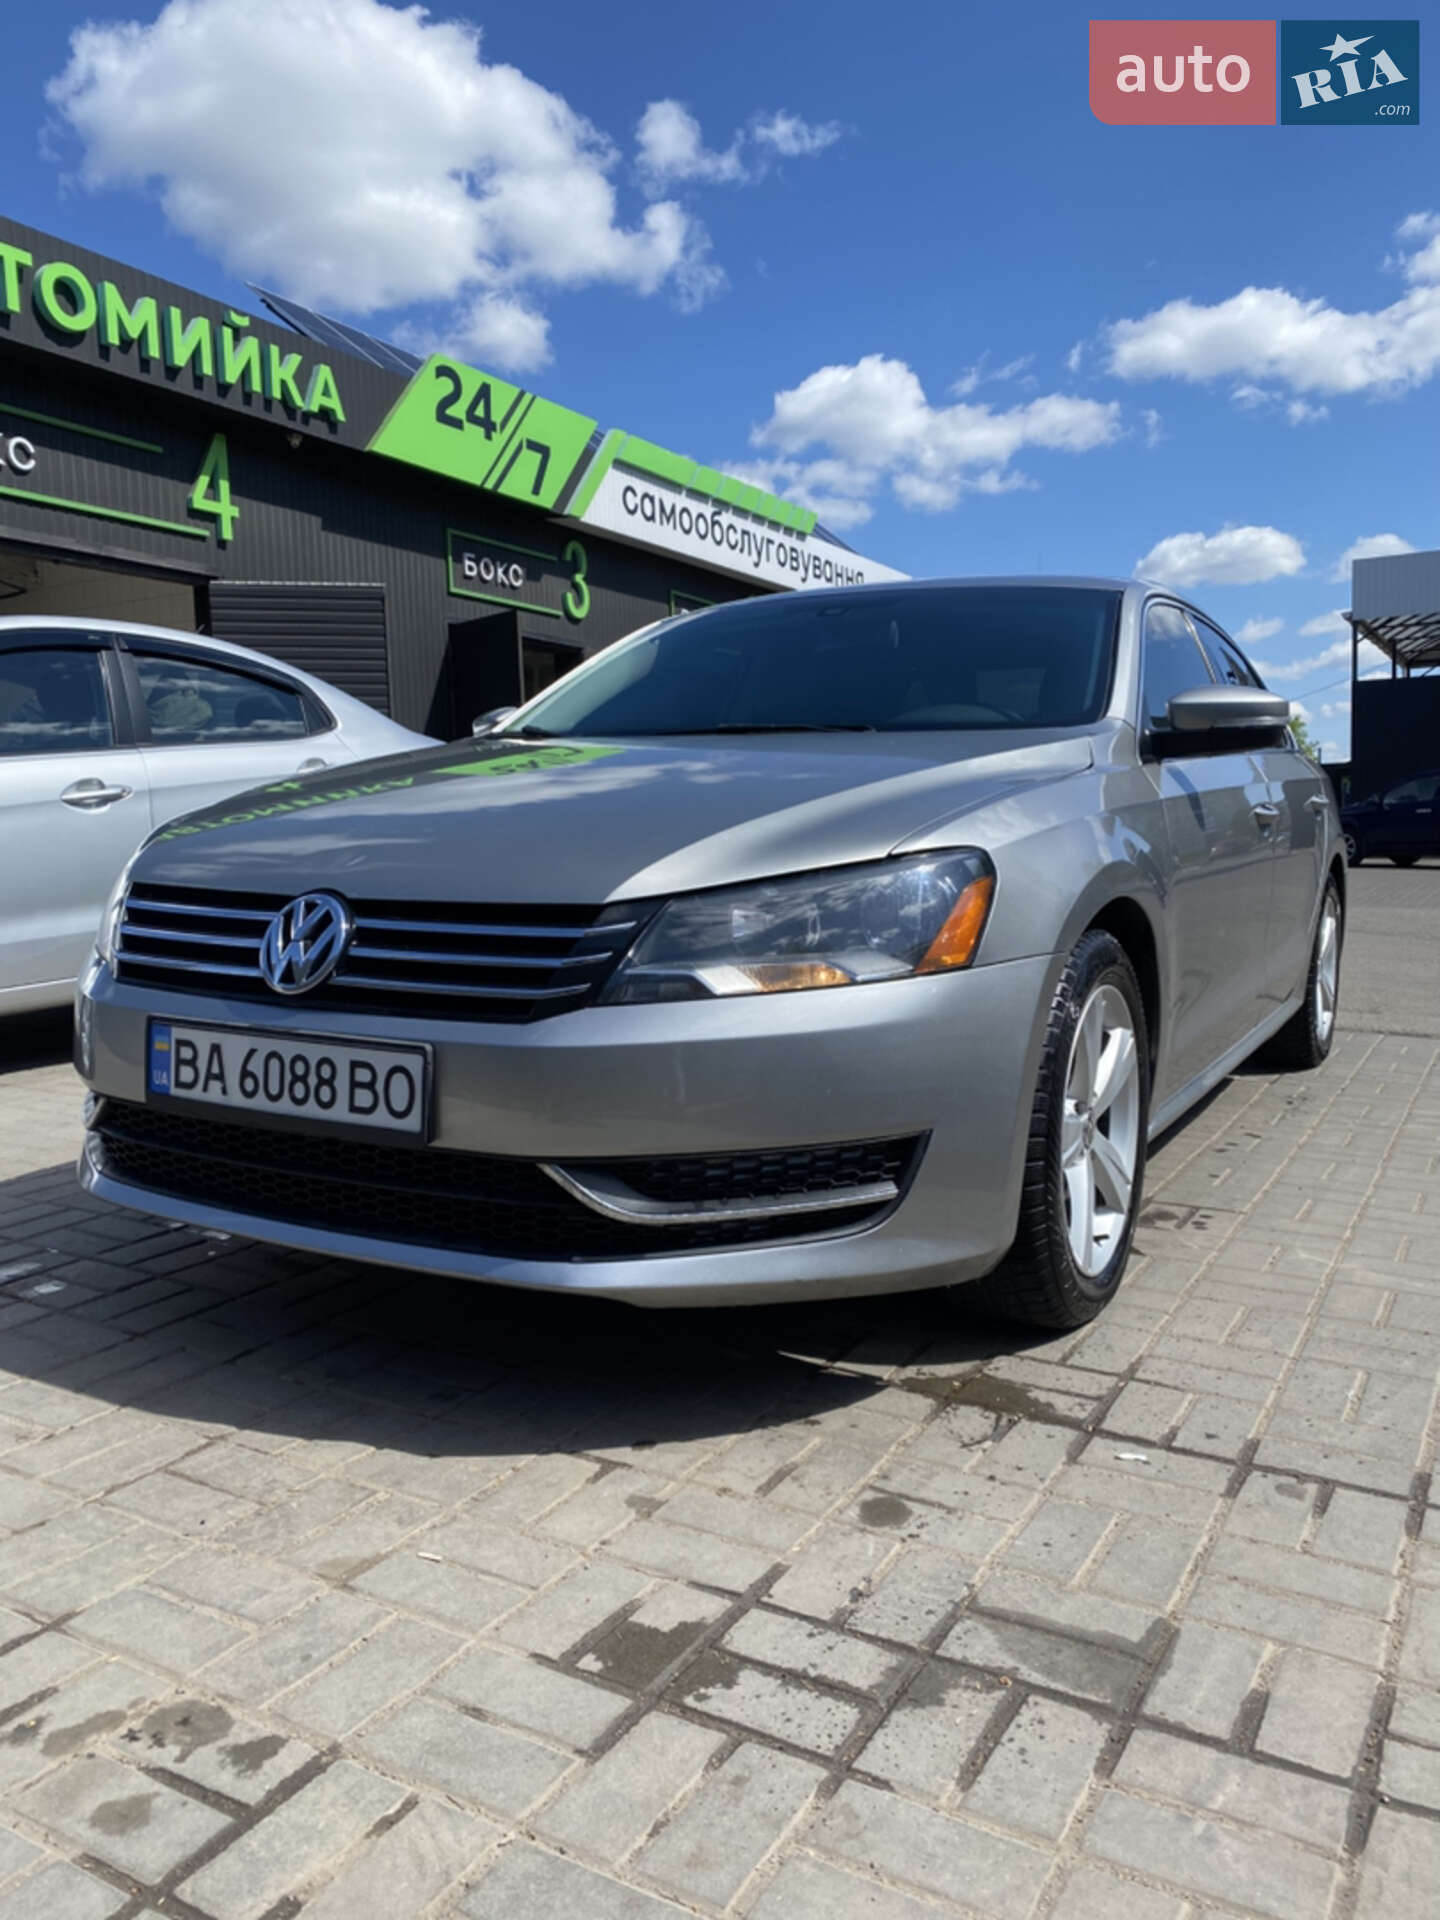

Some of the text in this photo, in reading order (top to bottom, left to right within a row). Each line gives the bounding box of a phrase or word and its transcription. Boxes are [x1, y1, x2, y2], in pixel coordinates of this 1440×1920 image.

[0, 241, 346, 424] ТОМИЙКА
[187, 433, 239, 541] 4
[562, 540, 590, 620] 3
[153, 1069, 169, 1086] UA
[239, 1048, 338, 1110] 6088
